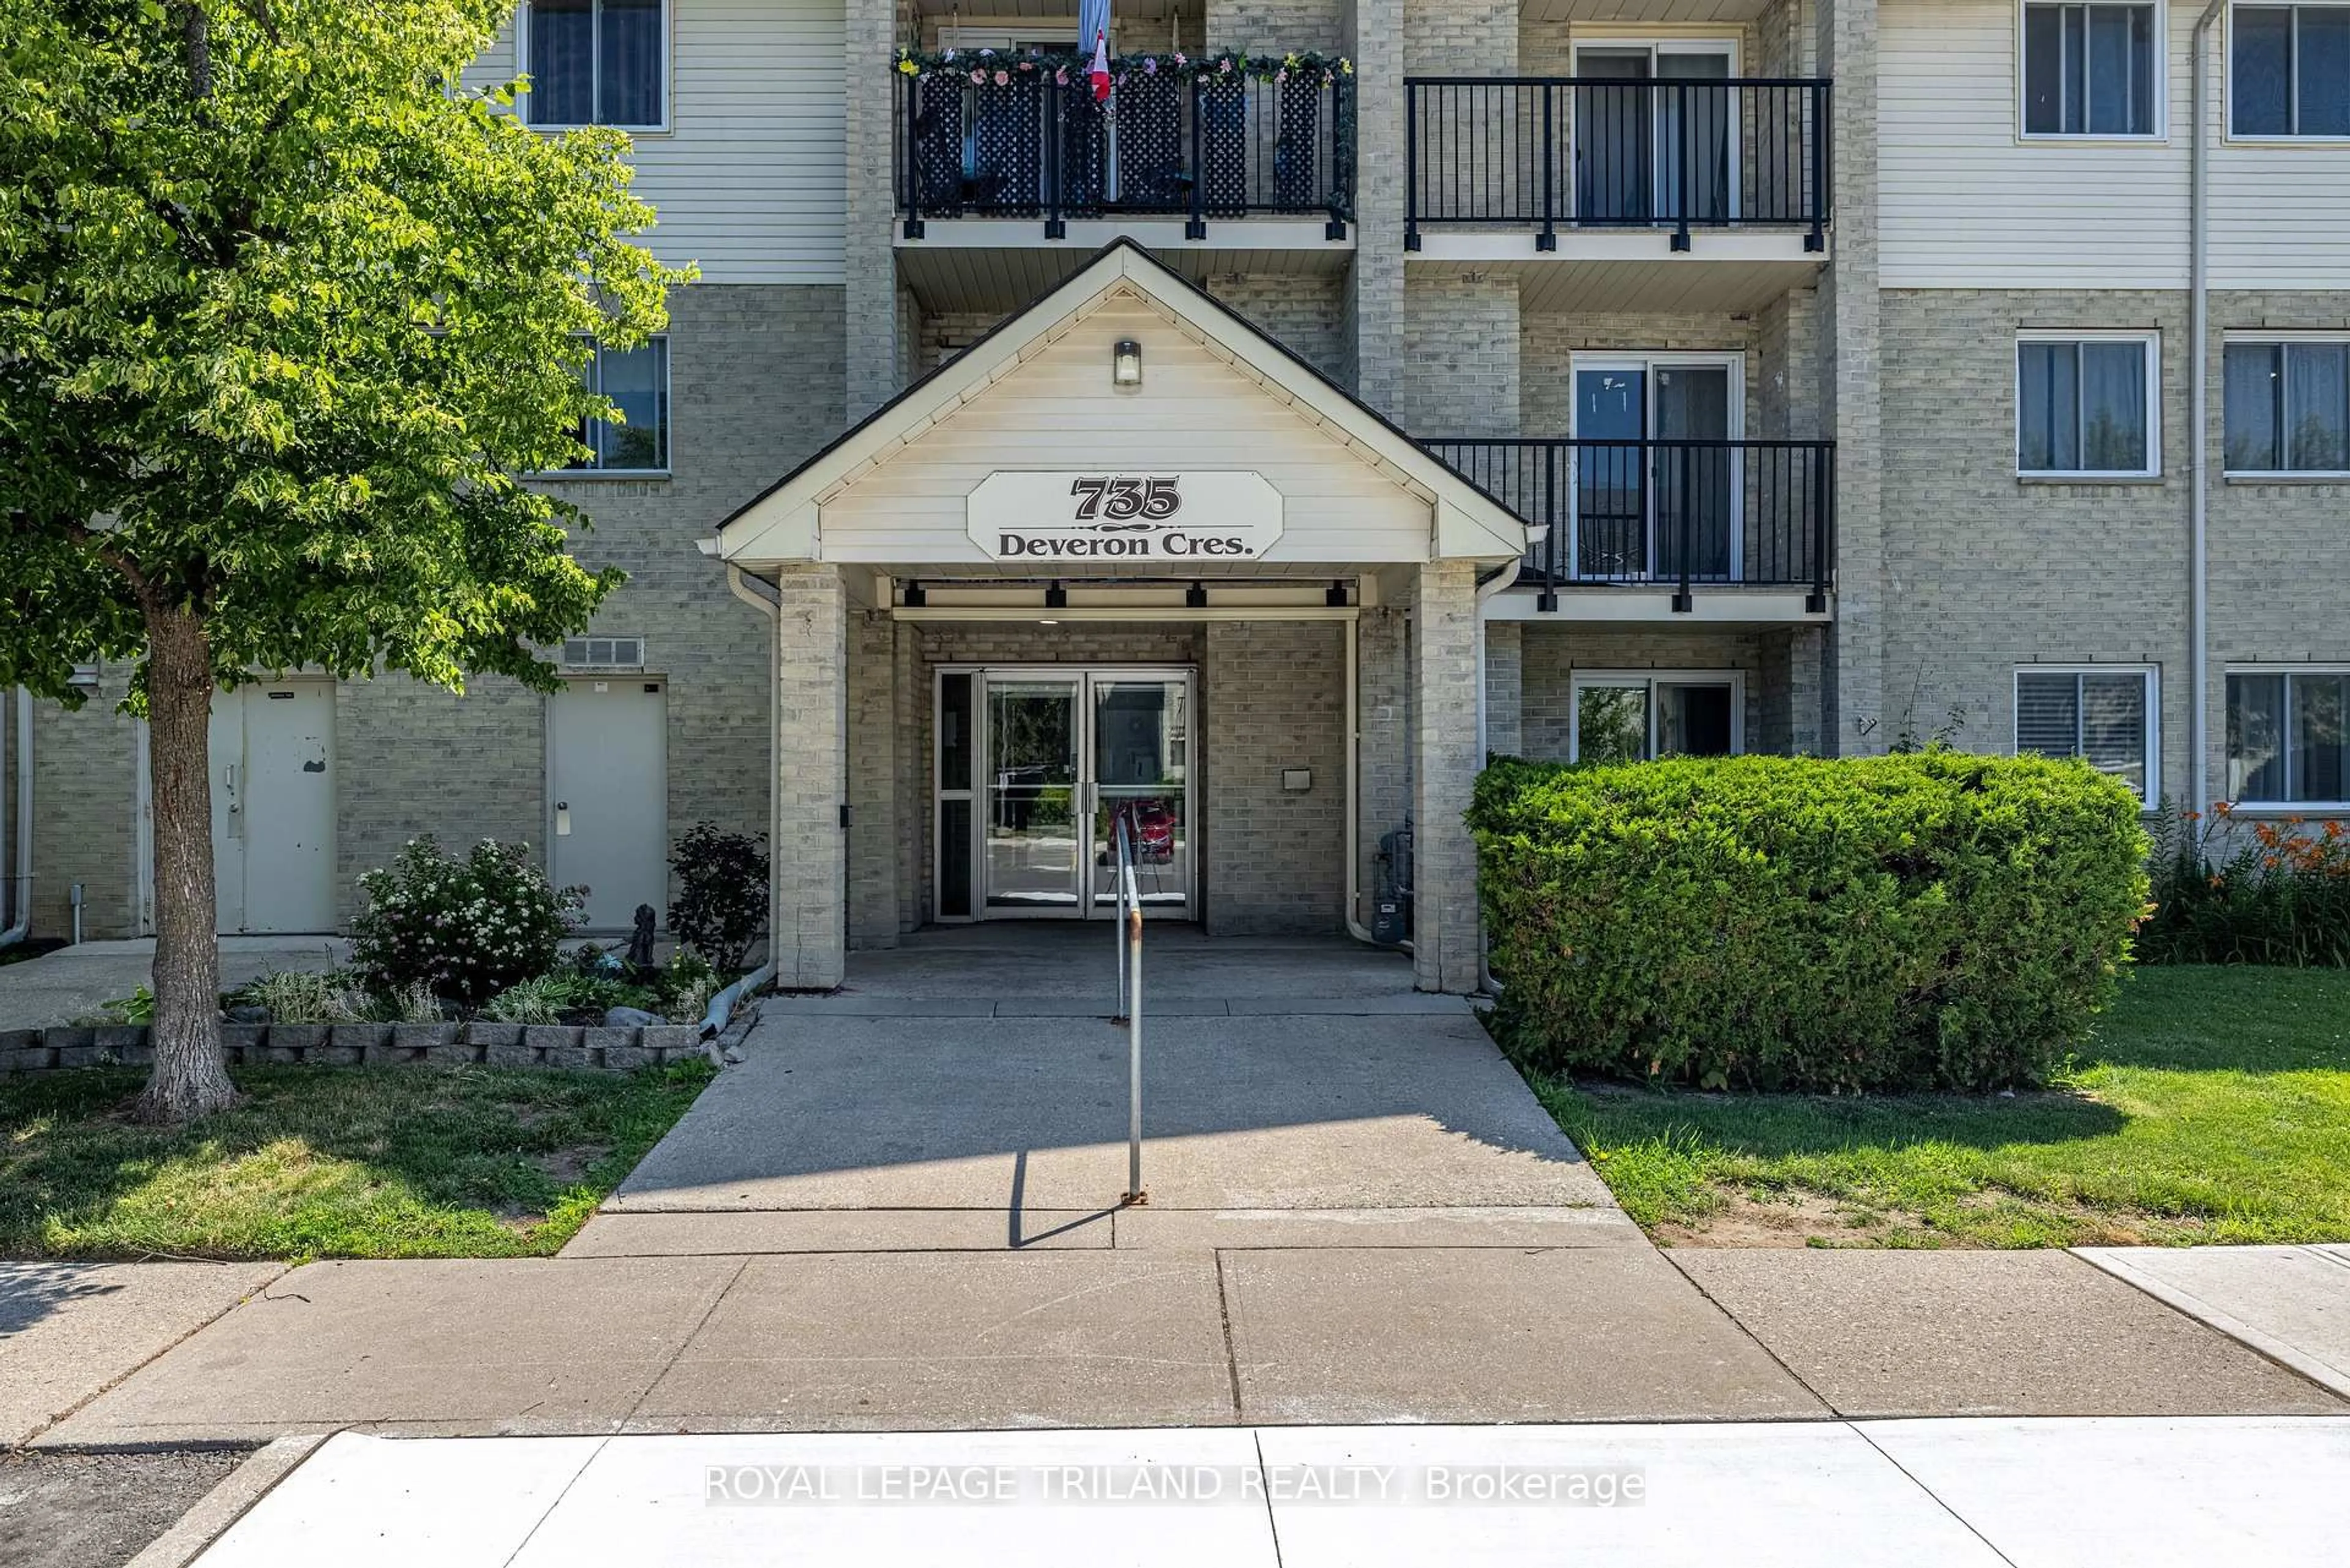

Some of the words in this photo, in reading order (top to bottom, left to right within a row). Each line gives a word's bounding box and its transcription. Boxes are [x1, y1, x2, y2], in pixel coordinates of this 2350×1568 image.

[1070, 476, 1182, 520] 735
[999, 534, 1149, 556] Deveron
[1163, 534, 1253, 556] Cres.
